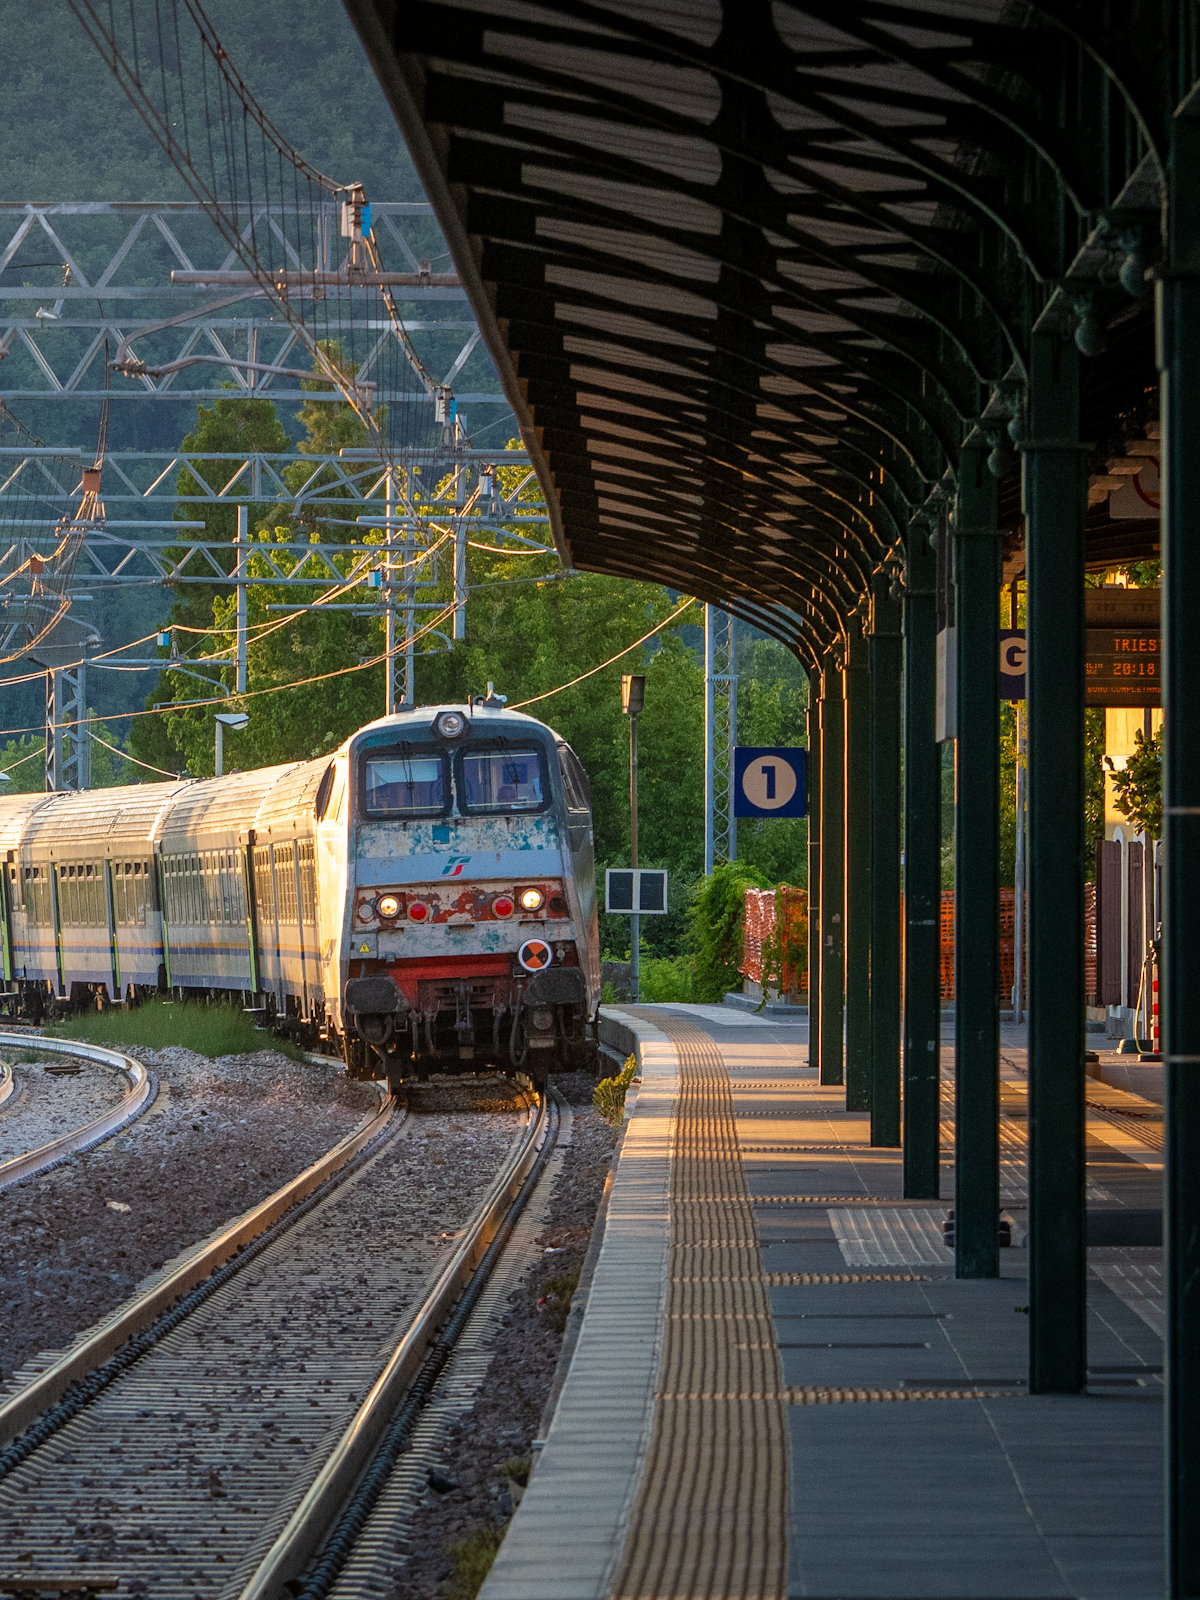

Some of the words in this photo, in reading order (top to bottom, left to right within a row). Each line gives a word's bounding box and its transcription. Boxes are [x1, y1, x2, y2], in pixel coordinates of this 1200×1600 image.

[1006, 646, 1026, 667] G
[1113, 662, 1155, 676] 20:18
[761, 765, 776, 800] 1
